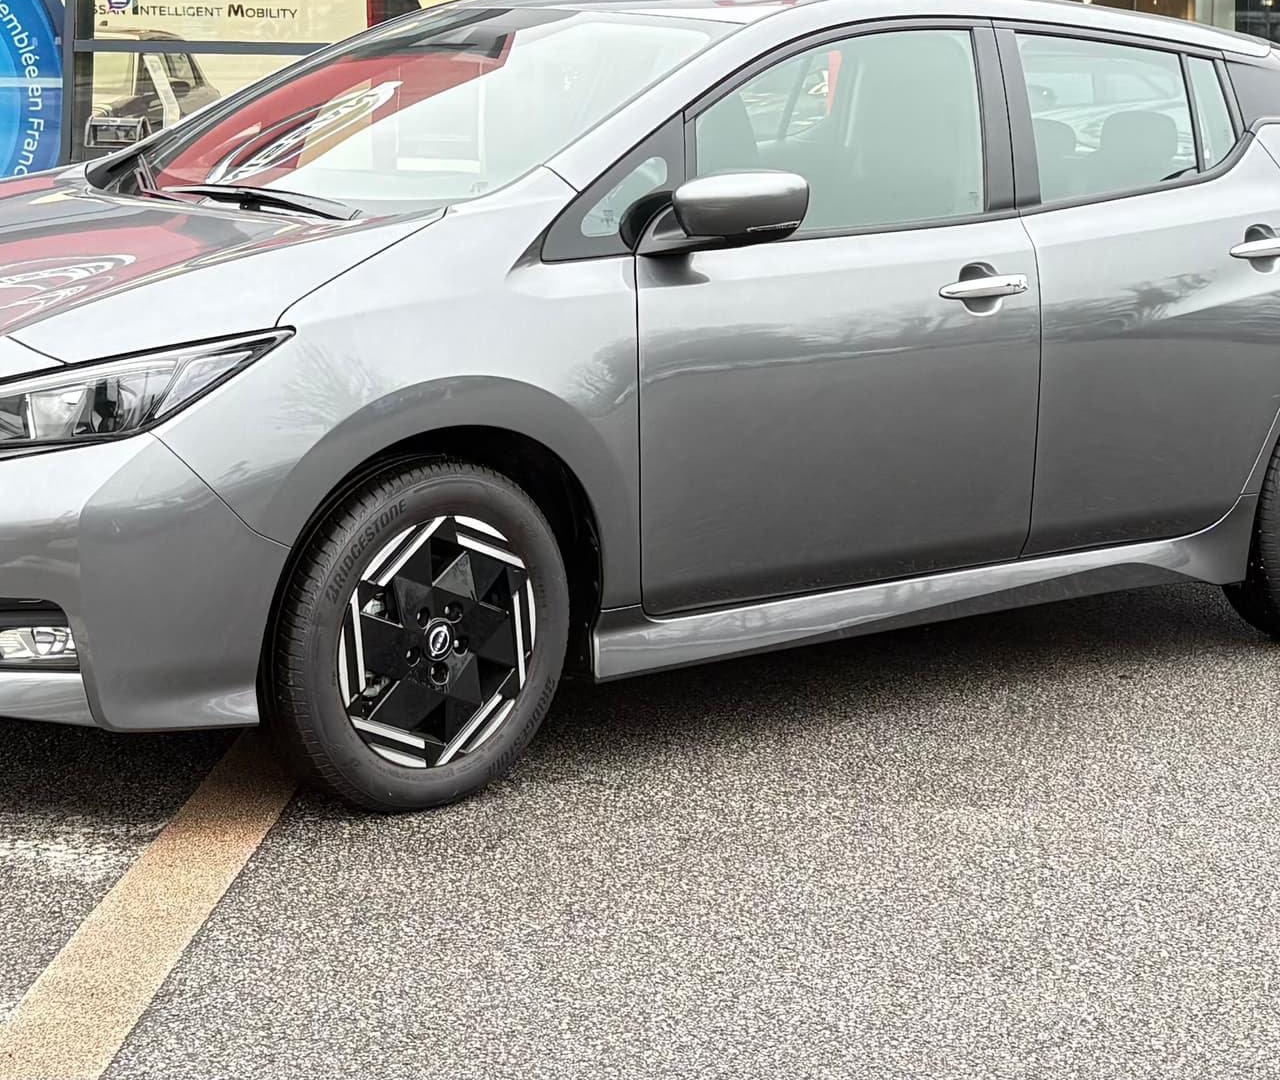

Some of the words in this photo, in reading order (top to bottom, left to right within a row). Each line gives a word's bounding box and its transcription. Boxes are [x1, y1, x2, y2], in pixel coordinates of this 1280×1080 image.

[227, 3, 298, 19] MOBILITY
[28, 84, 42, 111] en
[325, 498, 409, 606] BRIDGESTONE
